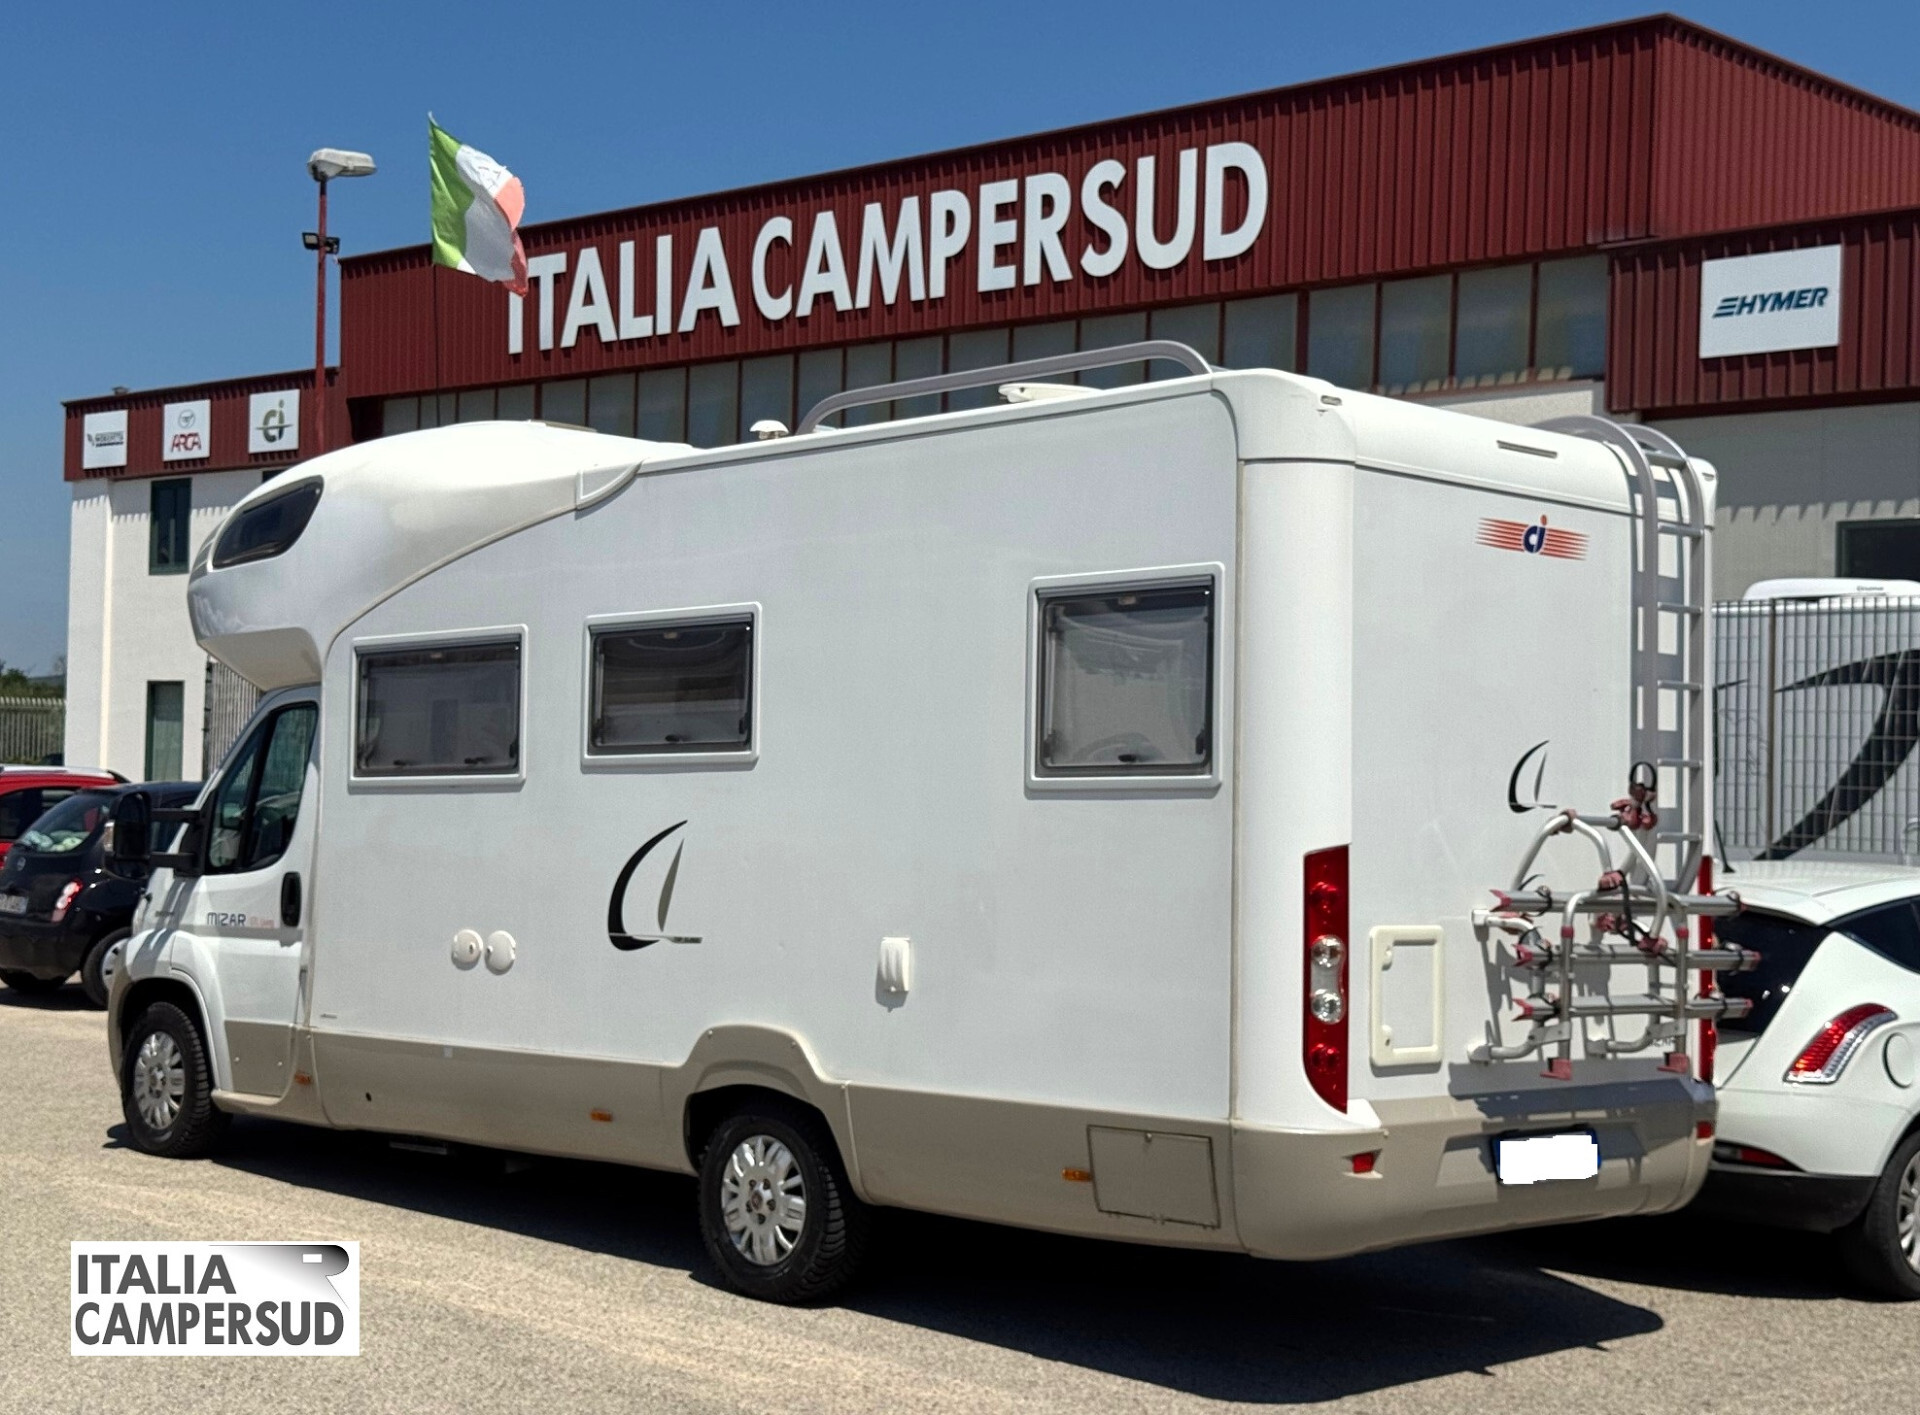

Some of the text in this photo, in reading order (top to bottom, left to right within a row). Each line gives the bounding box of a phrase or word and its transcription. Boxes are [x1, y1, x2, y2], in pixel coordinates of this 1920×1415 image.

[508, 141, 1269, 355] ITALIA CAMPERSUD
[1735, 286, 1829, 316] HYMER
[170, 432, 202, 453] ARCA
[207, 911, 247, 928] MIZAR
